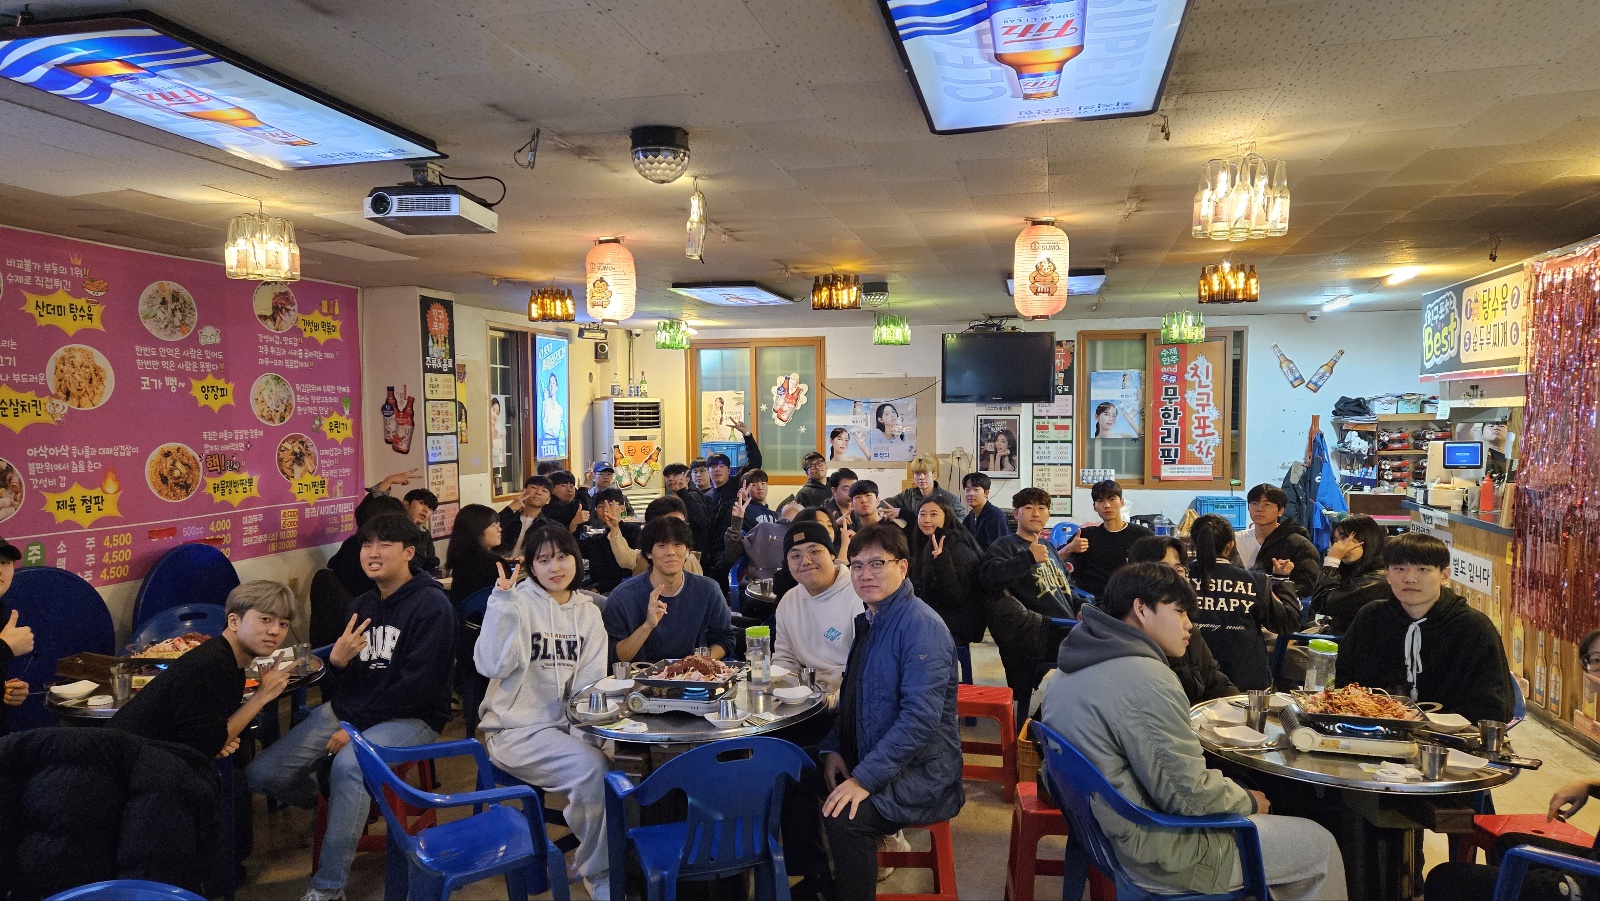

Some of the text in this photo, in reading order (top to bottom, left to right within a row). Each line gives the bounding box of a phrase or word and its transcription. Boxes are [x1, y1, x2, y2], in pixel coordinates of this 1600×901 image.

[1002, 18, 1079, 45] Fitz
[6, 258, 41, 272] 비교불가
[44, 263, 67, 274] 부동의
[6, 273, 71, 291] 수제로 직접튀긴
[1482, 283, 1508, 321] 탕수육
[36, 301, 94, 323] 산더미 탕수육
[302, 318, 337, 336] 갓성비 떡볶이
[0, 338, 17, 350] 리는
[1424, 312, 1457, 362] Best
[1472, 321, 1508, 352] 순두부찌개
[135, 345, 223, 360] 한번도 안먹은 사람은 있어도
[1161, 347, 1178, 356] 수제
[136, 359, 159, 370] 한번만
[161, 360, 176, 371] 먹은
[178, 361, 198, 372] 사람은
[426, 357, 453, 371] 주류&음료
[1161, 365, 1177, 373] and
[1162, 356, 1179, 365] 안주
[13, 373, 46, 385] 부드러운
[141, 376, 162, 390] 코가
[201, 385, 228, 400] 양장피
[0, 399, 41, 417] 순살치킨
[1190, 363, 1215, 458] 친구포차
[328, 422, 347, 433] 유린기
[1159, 386, 1182, 464] 무한리필
[219, 430, 233, 440] 해물과
[27, 445, 139, 459] 아삭아삭 콩나물과 대패삼겹살이
[28, 460, 102, 475] 불판위에서 춤을 춘다
[206, 454, 226, 473] 핵!
[29, 476, 66, 489] 갓성비 갑
[213, 477, 254, 495] 해물쟁반짬뽕
[297, 480, 326, 495] 고기짬뽕
[56, 495, 105, 514] 제육 철판
[183, 519, 231, 536] 500cc 4,000
[57, 533, 132, 553] 소 주 4,500
[28, 546, 41, 563] 주
[86, 554, 95, 567] 주
[102, 549, 131, 564] 4,500
[100, 565, 129, 580] 4,500
[1453, 556, 1490, 587] 별도 입니다
[1187, 578, 1257, 596] YSICAL
[530, 632, 584, 662] SLAK
